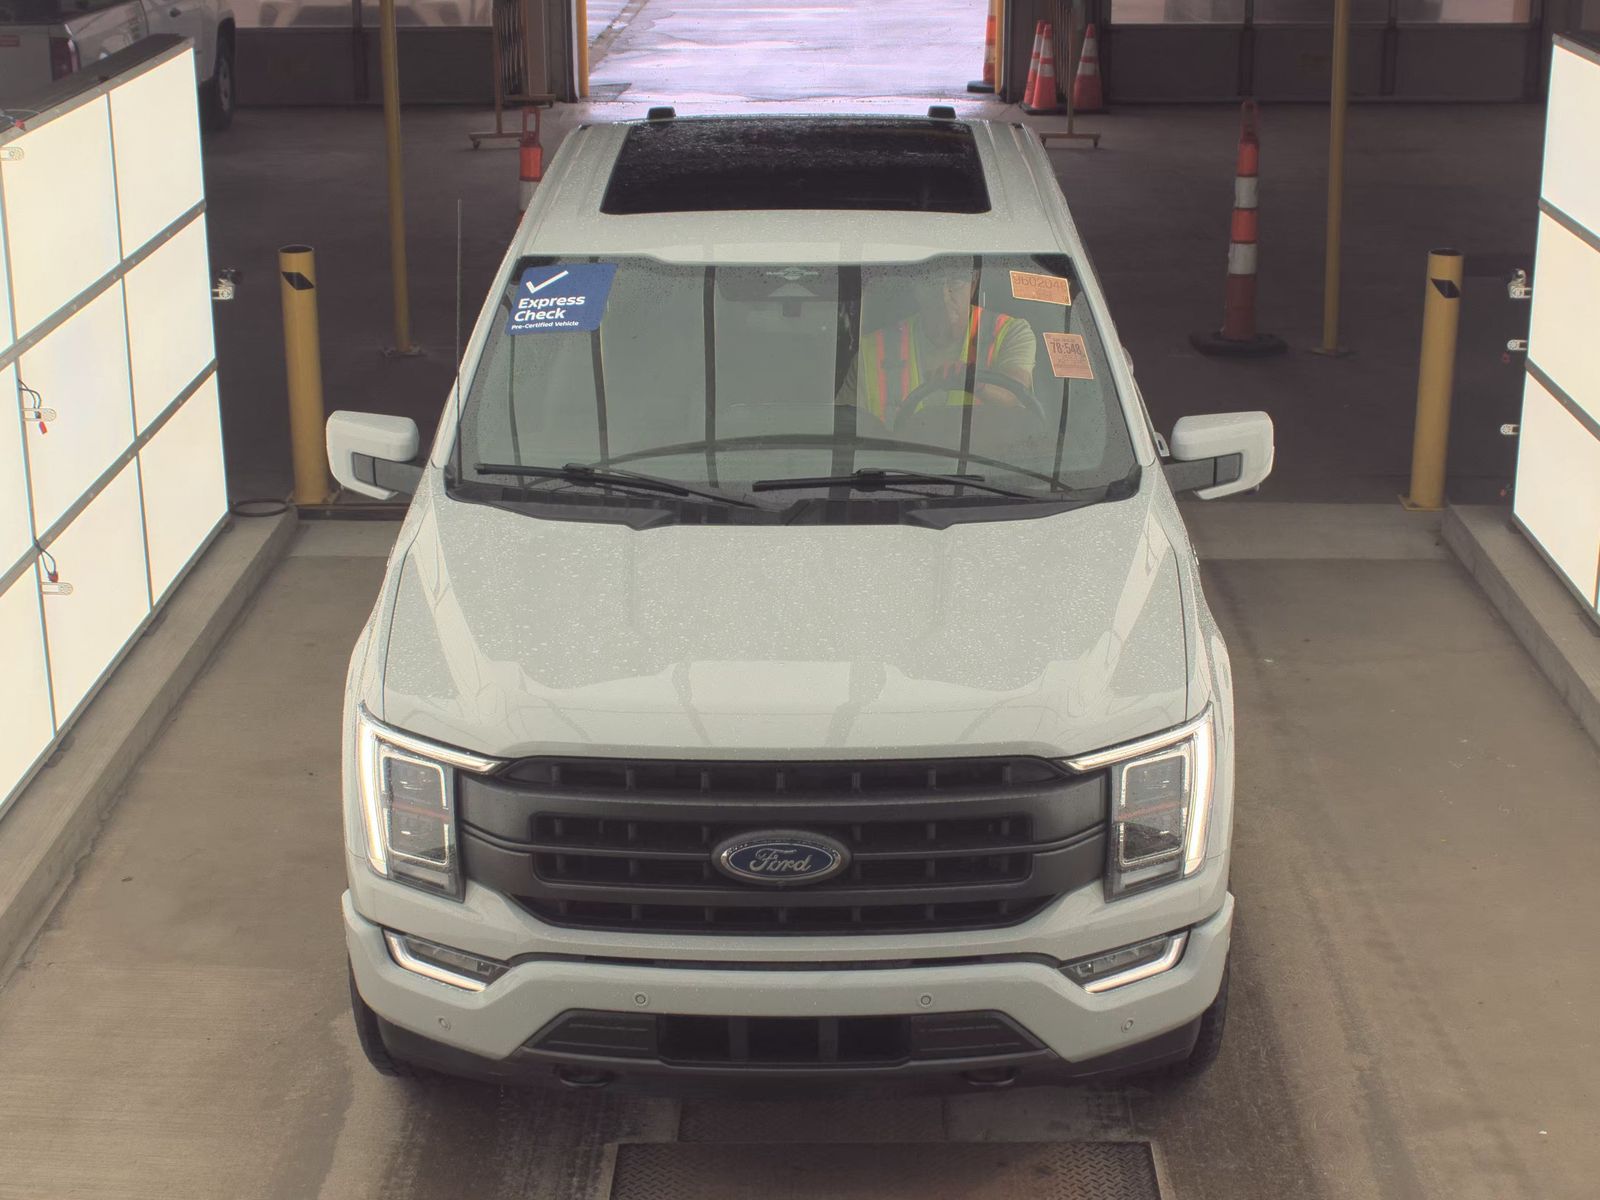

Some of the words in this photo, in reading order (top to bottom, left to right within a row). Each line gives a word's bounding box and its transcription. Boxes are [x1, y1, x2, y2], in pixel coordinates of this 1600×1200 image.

[518, 296, 586, 310] Express
[514, 307, 567, 322] Check
[511, 321, 554, 330] Pre-Certified
[749, 848, 813, 872] Ford
